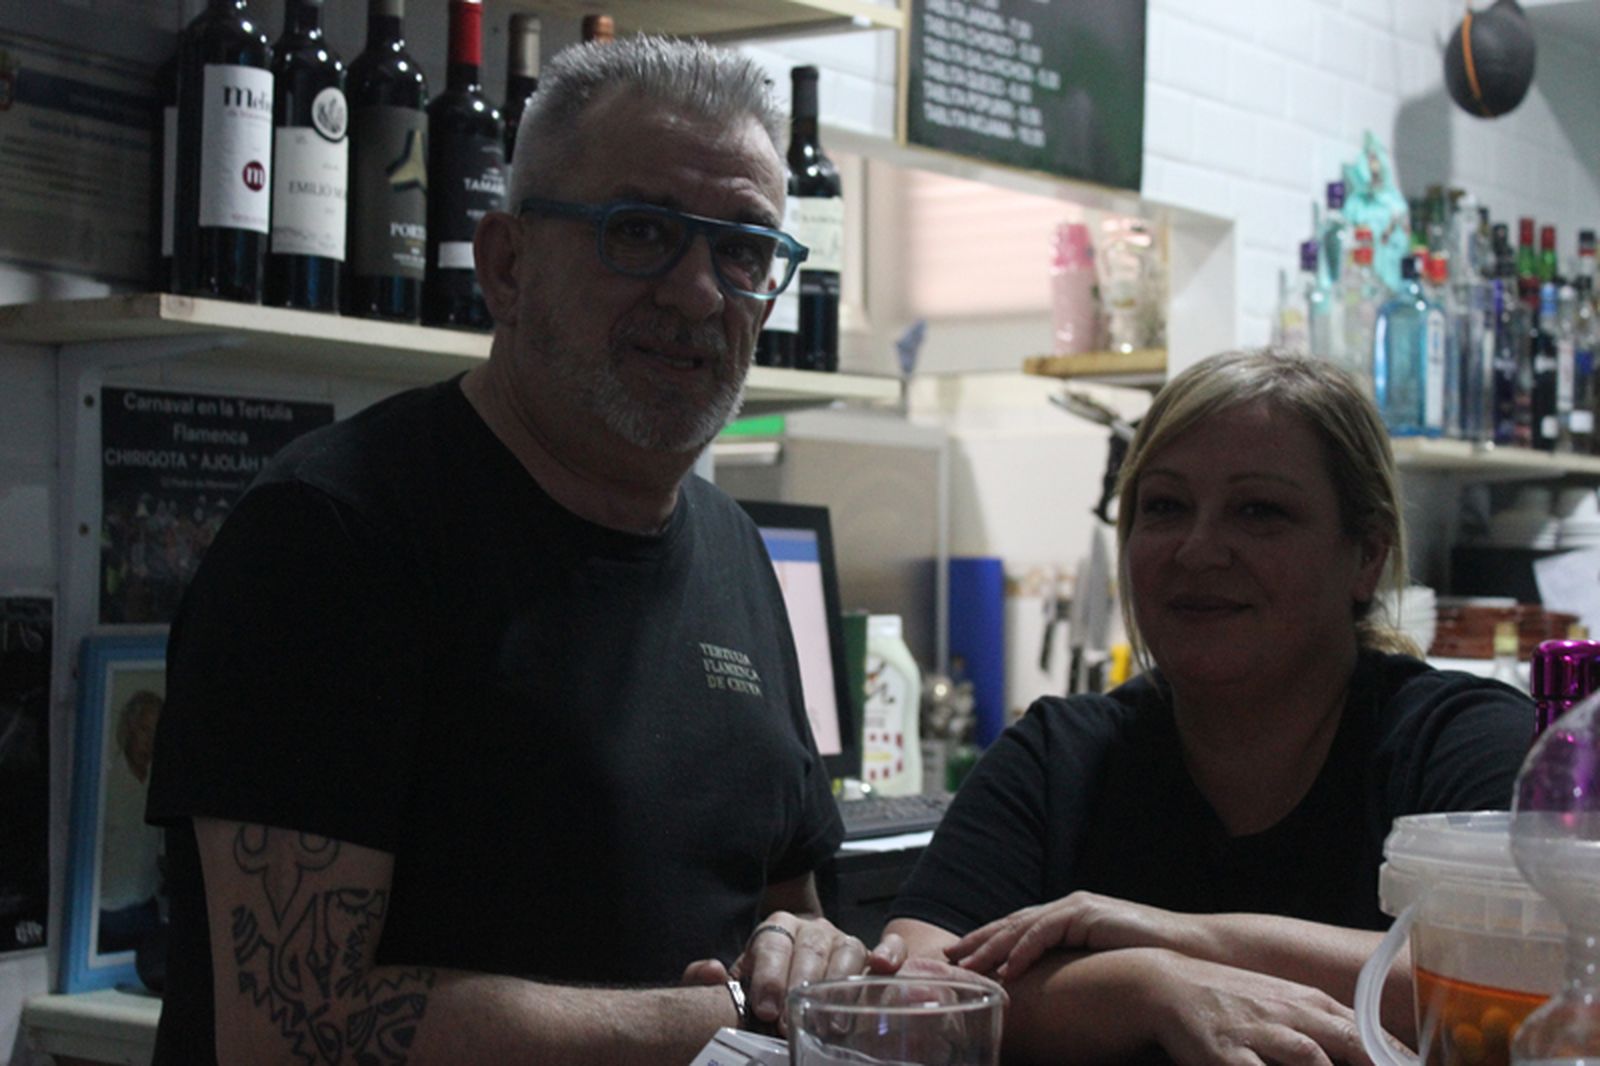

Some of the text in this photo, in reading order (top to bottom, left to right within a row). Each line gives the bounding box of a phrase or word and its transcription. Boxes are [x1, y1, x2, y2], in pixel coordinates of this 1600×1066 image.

[123, 392, 293, 422] Carnaval en la Tertulia
[172, 422, 249, 446] Flamenca
[104, 448, 187, 470] CHIRIGOTA
